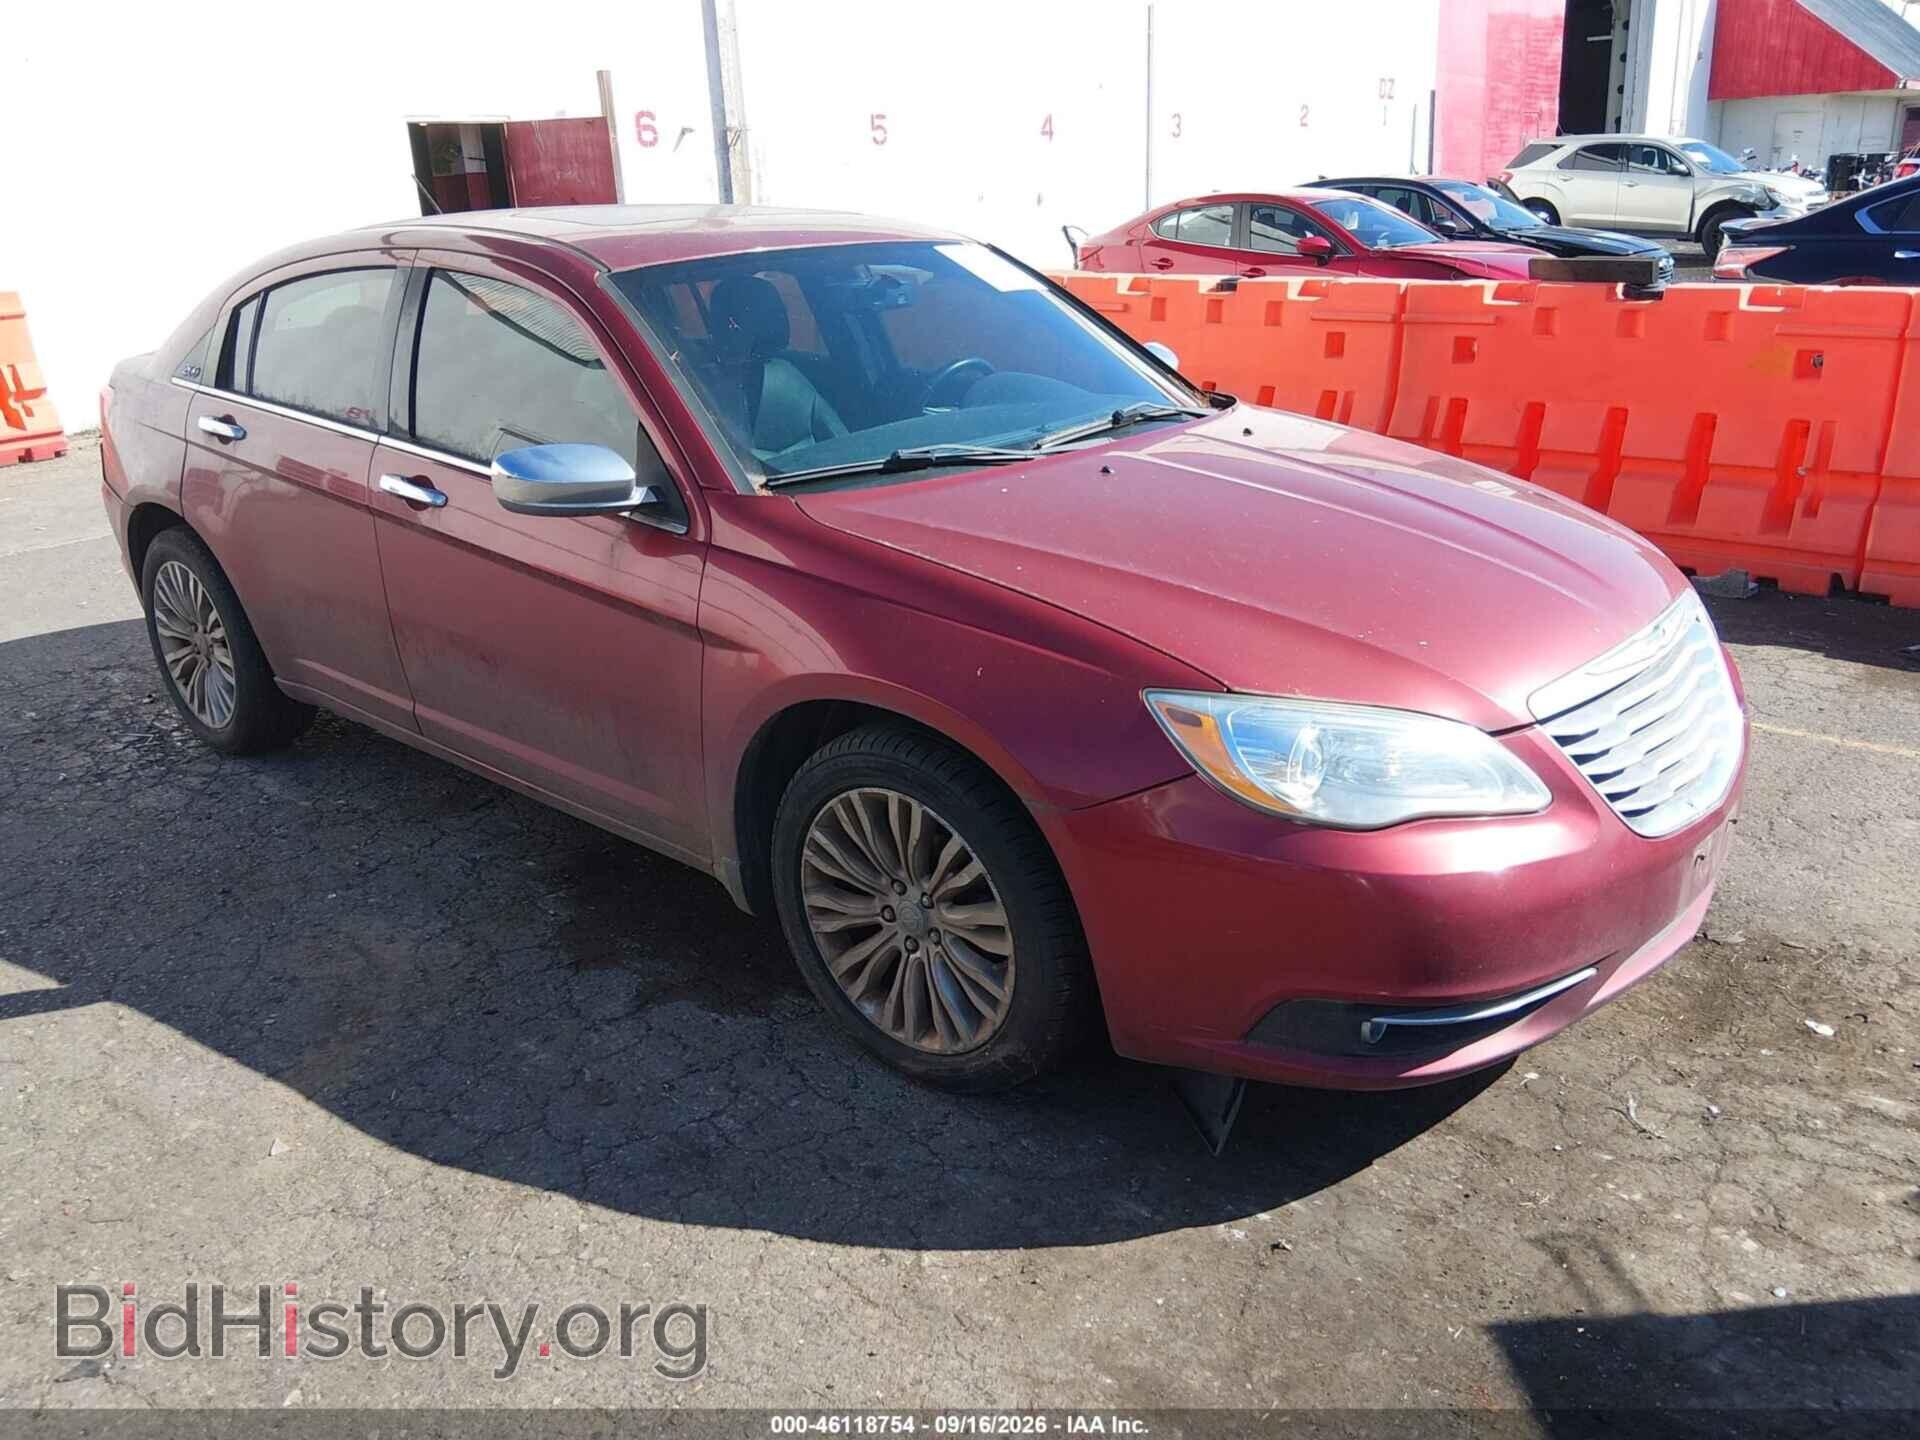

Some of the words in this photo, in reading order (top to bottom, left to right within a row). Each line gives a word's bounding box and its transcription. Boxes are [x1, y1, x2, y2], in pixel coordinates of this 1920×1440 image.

[634, 109, 659, 148] 6
[870, 113, 888, 146] 5
[1040, 114, 1054, 142] 4
[1171, 113, 1183, 139] 3
[1299, 104, 1309, 128] 2
